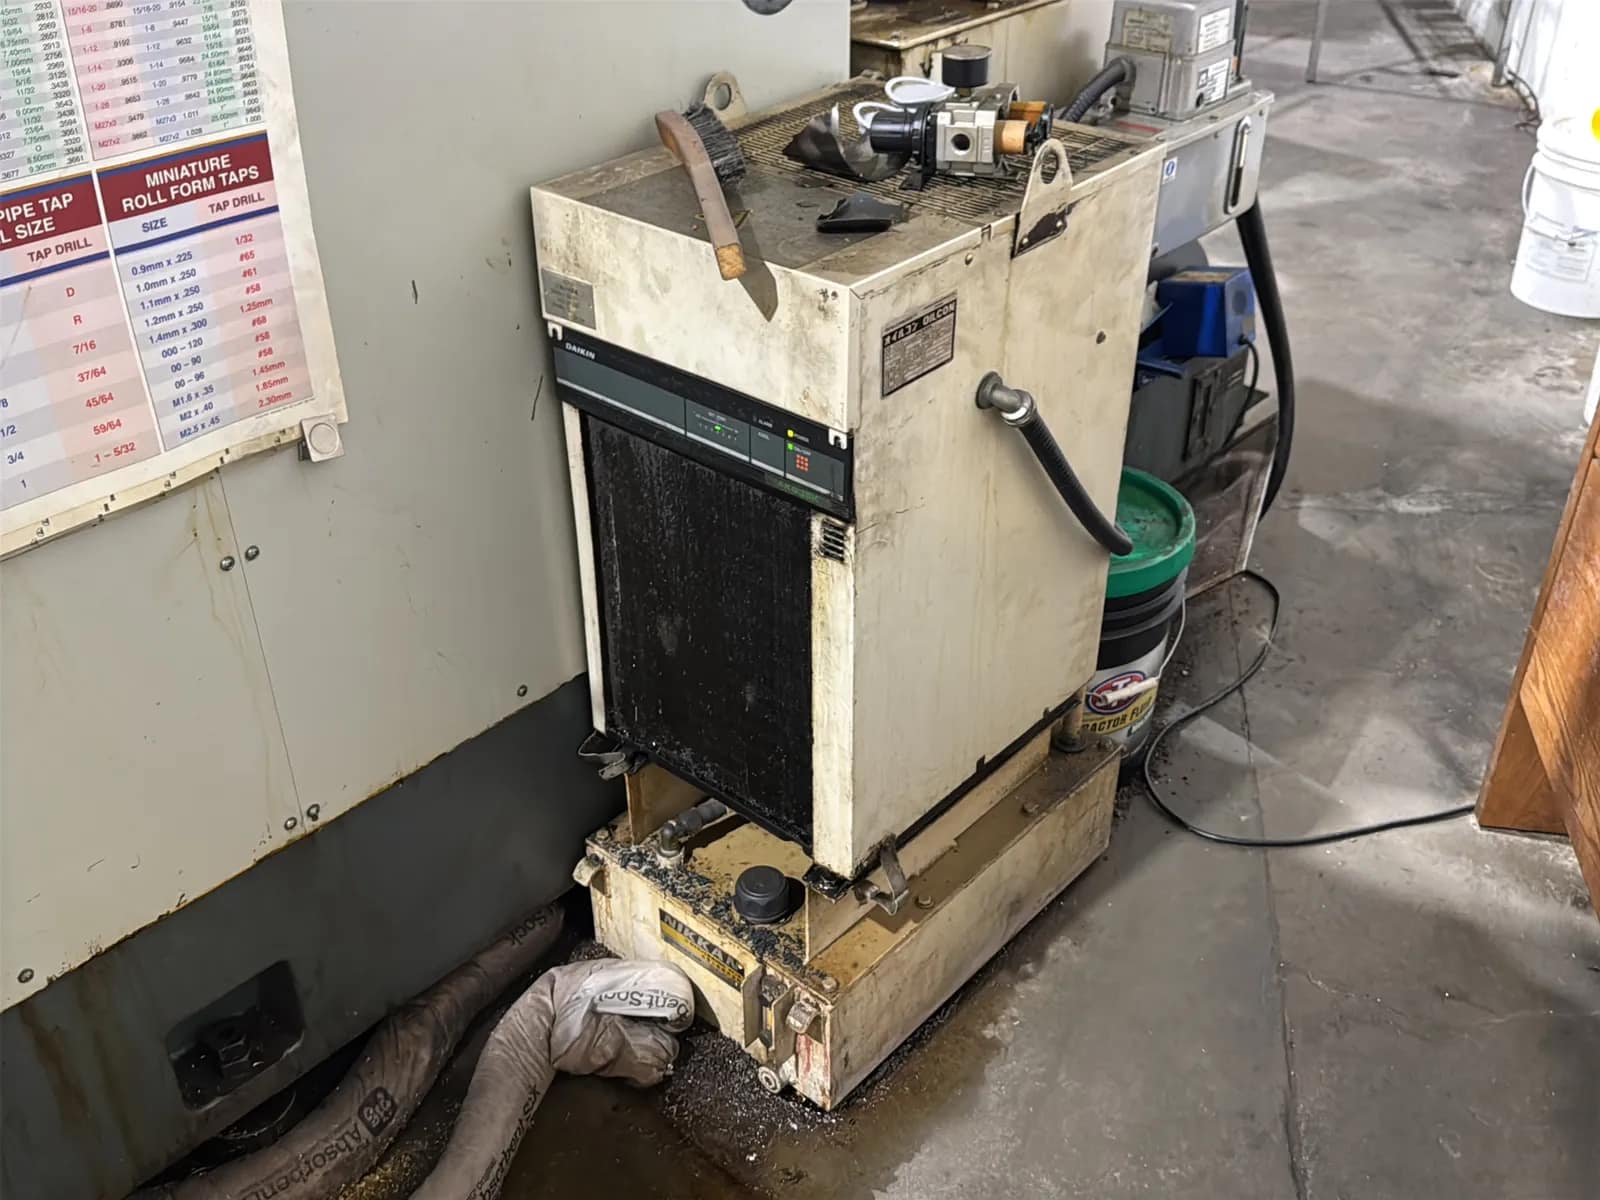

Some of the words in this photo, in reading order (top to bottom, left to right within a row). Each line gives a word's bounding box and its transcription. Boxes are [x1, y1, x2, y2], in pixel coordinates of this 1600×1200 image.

[146, 154, 232, 188] MINIATURE
[122, 190, 168, 213] ROLL
[169, 178, 216, 201] FORM
[219, 166, 260, 188] TAPS
[38, 193, 74, 214] TAP
[208, 200, 230, 215] TAP
[232, 191, 265, 208] DRILL
[15, 217, 56, 240] SIZE
[142, 218, 168, 234] SIZE
[236, 233, 253, 246] 1/32
[27, 248, 52, 263] TAP
[55, 238, 93, 256] DRILL
[239, 250, 255, 263] #65
[131, 260, 164, 277] 0.9mm
[66, 287, 75, 297] D
[136, 278, 168, 294] 1.0mm
[140, 295, 172, 311] 1.1mm
[240, 297, 274, 314] 1.25mm
[73, 314, 83, 326] R
[145, 312, 176, 328] 1.2mm
[149, 329, 180, 346] 1.4mm
[72, 340, 96, 356] 7/16
[162, 346, 178, 359] 000
[188, 337, 204, 350] 120
[565, 342, 596, 360] DAIKIN
[171, 362, 183, 374] 00
[191, 355, 202, 367] 90
[77, 366, 106, 383] 37/64
[175, 378, 187, 390] 00
[85, 392, 114, 410] 45/64
[172, 390, 193, 408] M1.6
[258, 390, 292, 409] 2.30mm
[180, 408, 192, 422] M2
[0, 424, 17, 438] 1/2
[93, 418, 122, 436] 59/64
[180, 422, 199, 440] M2.5
[7, 451, 24, 465] 3/4
[95, 454, 101, 464] 1
[113, 441, 136, 457] 5/32
[21, 479, 27, 489] 1
